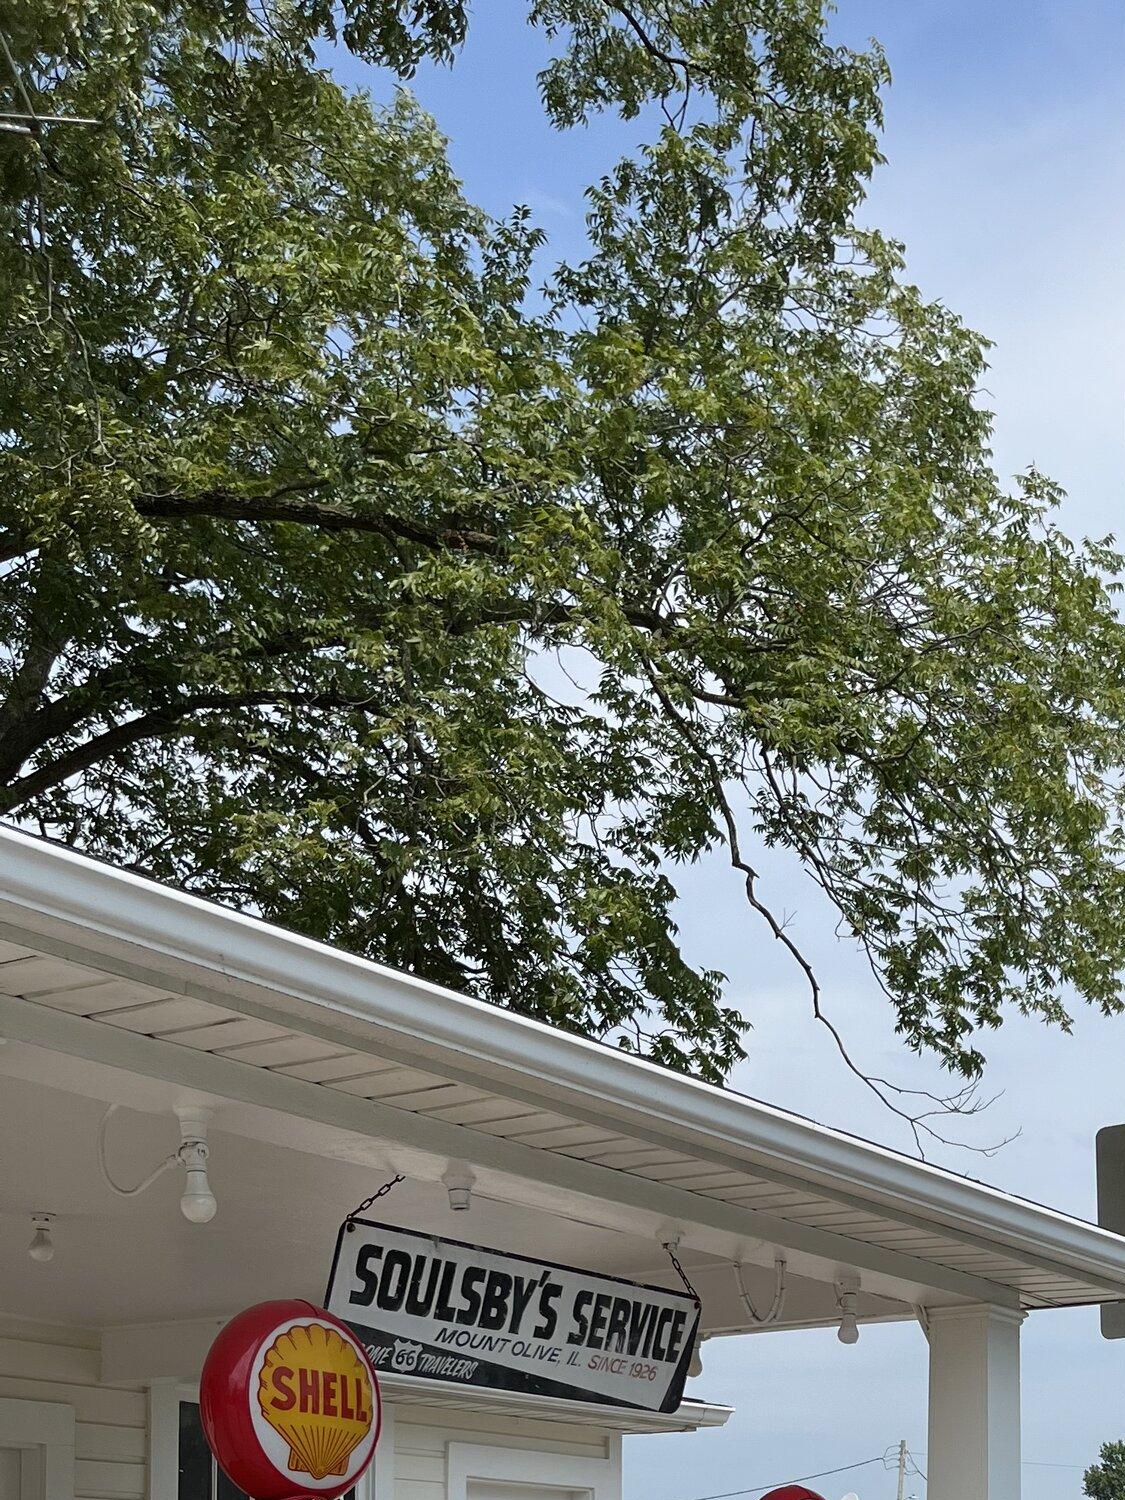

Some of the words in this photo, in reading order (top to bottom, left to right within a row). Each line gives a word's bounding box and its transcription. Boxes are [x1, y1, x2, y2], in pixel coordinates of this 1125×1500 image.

[348, 1242, 564, 1341] SOULSBY'S
[566, 1289, 688, 1364] SERVICE
[395, 1349, 416, 1366] 66
[418, 1353, 479, 1380] TRAVELERS
[435, 1327, 513, 1354] MOUNT
[511, 1340, 562, 1367] OLIVE,
[566, 1351, 582, 1367] IL.
[587, 1354, 628, 1374] SINCE
[628, 1362, 658, 1382] 1926
[270, 1366, 368, 1423] SHELL
